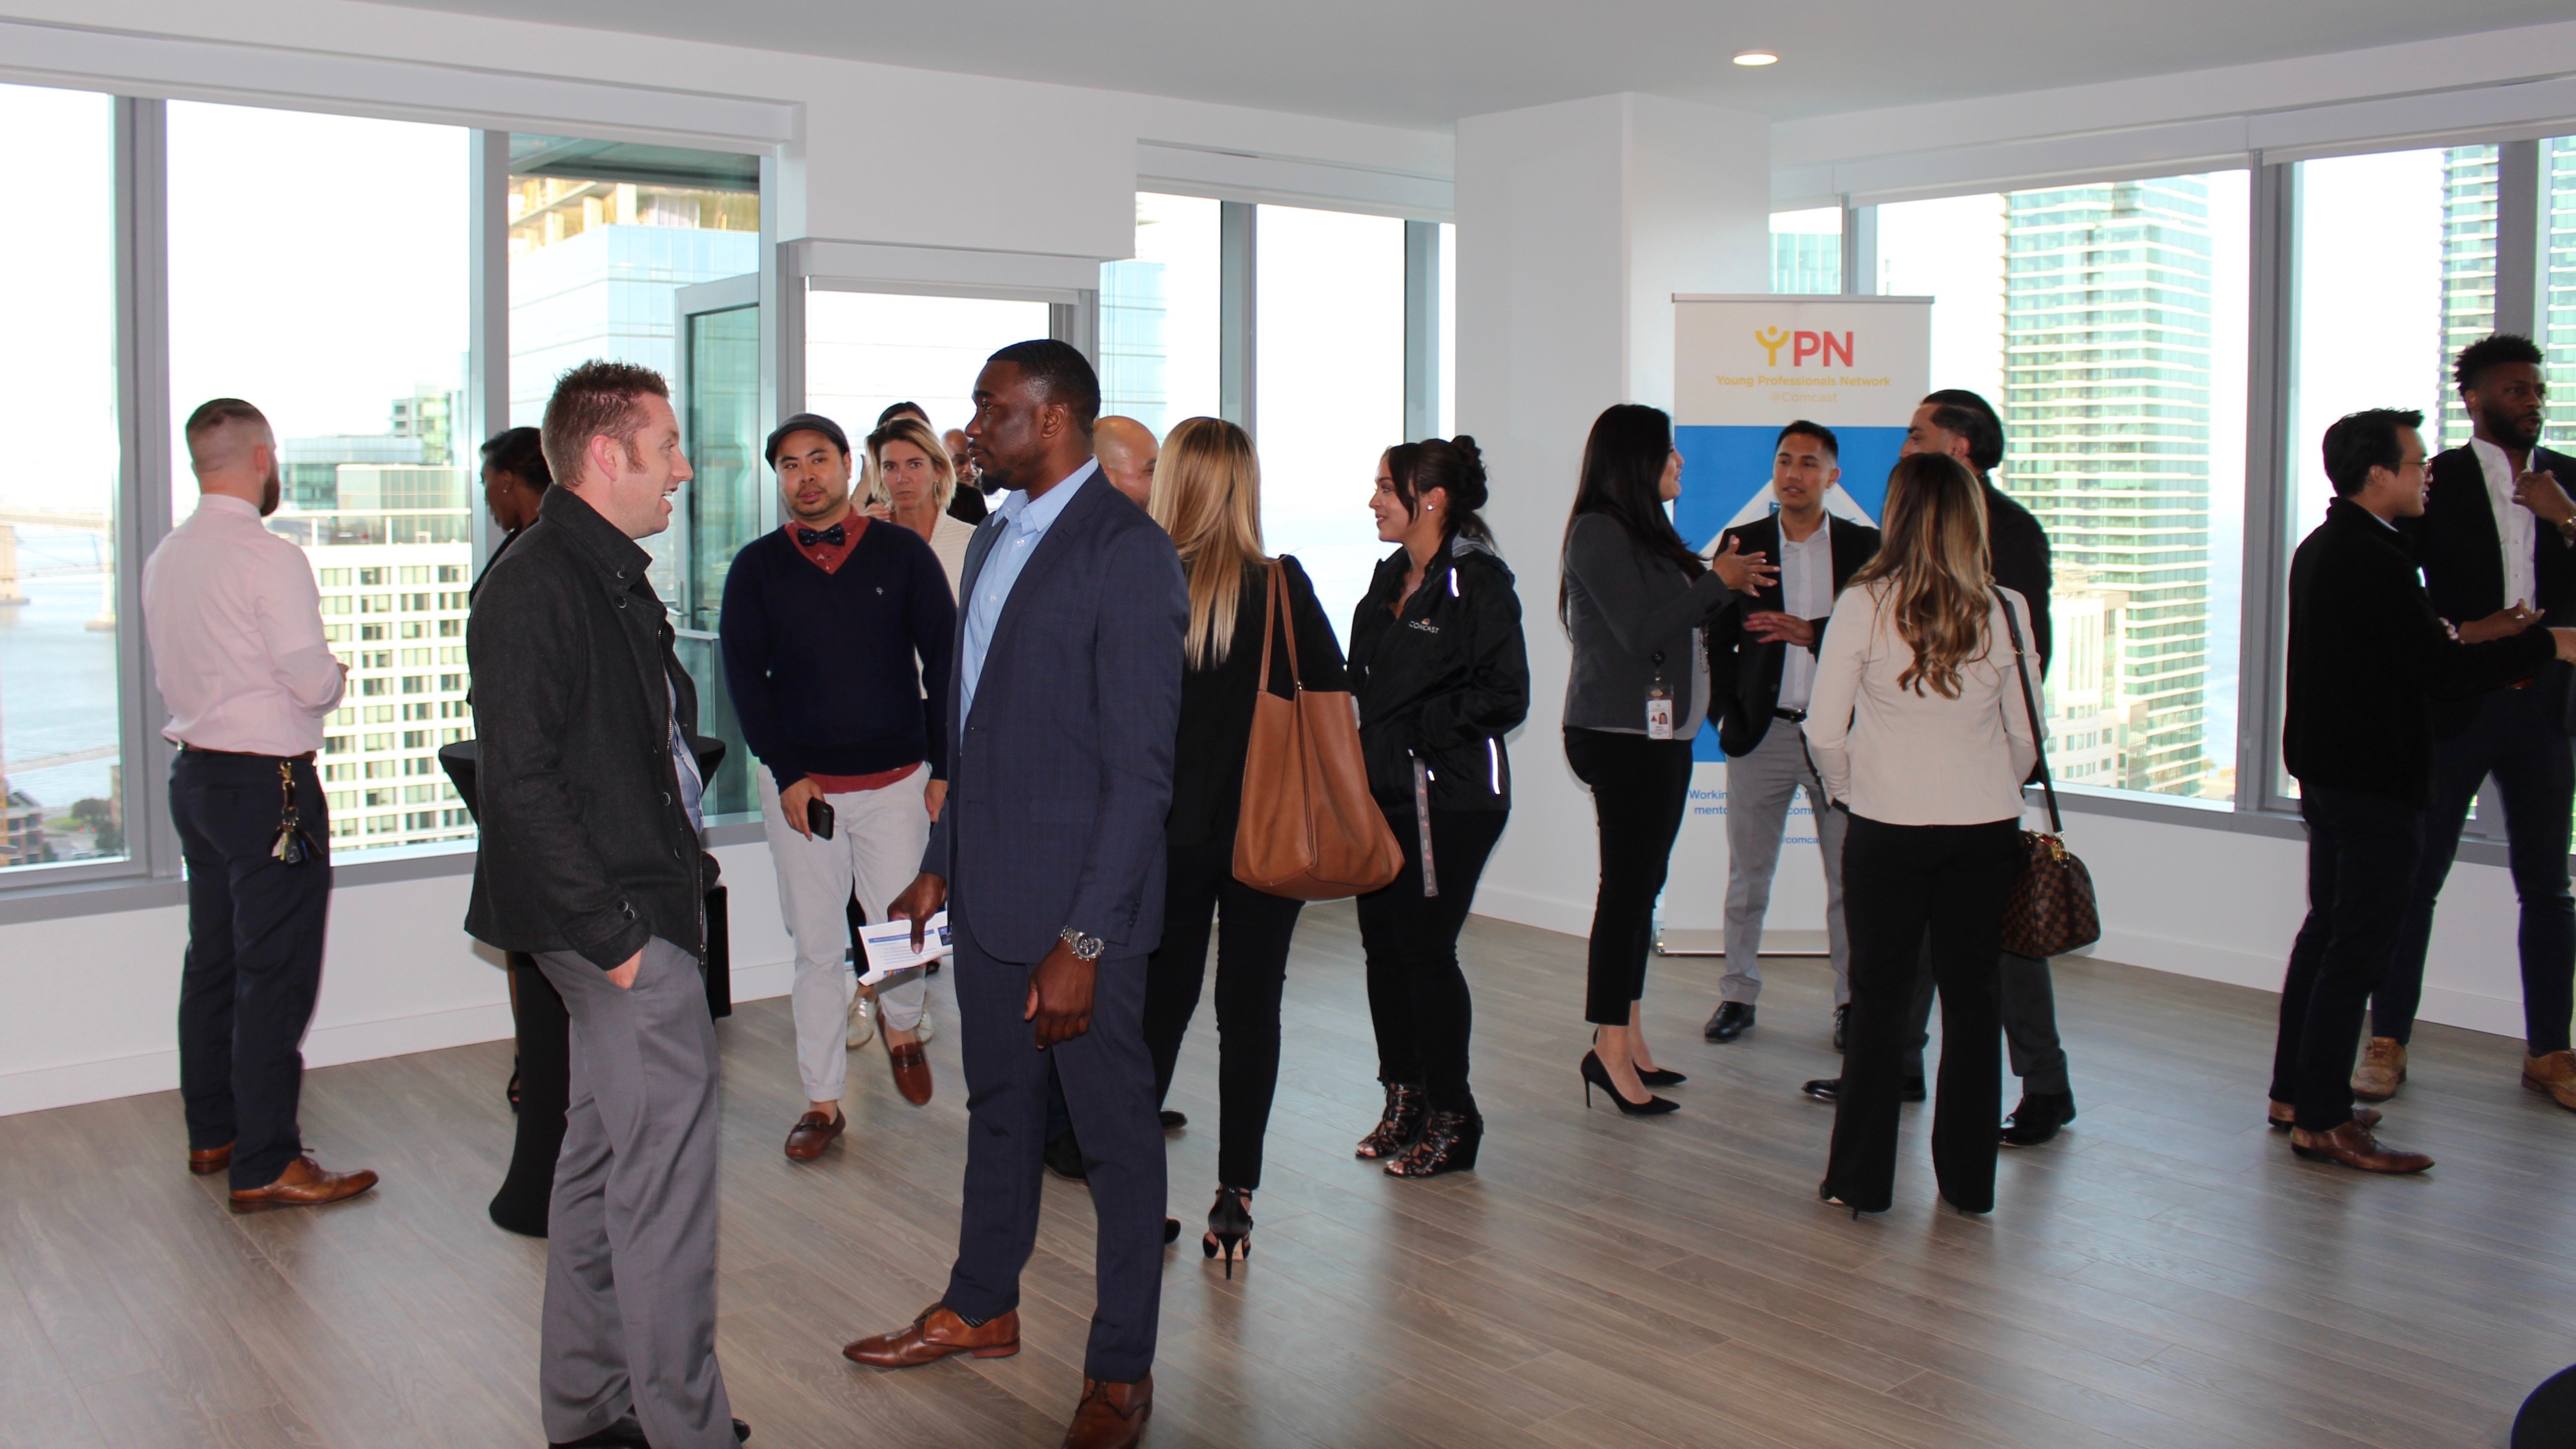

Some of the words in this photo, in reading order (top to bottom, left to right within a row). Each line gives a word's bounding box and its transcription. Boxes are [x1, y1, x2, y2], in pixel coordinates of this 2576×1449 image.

[1755, 326, 1854, 367] YPN
[1716, 375, 1754, 387] Young
[1758, 375, 1837, 386] Professionals
[1840, 376, 1891, 386] Network
[1771, 391, 1838, 403] @Comcast
[1409, 621, 1439, 634] COMCAST
